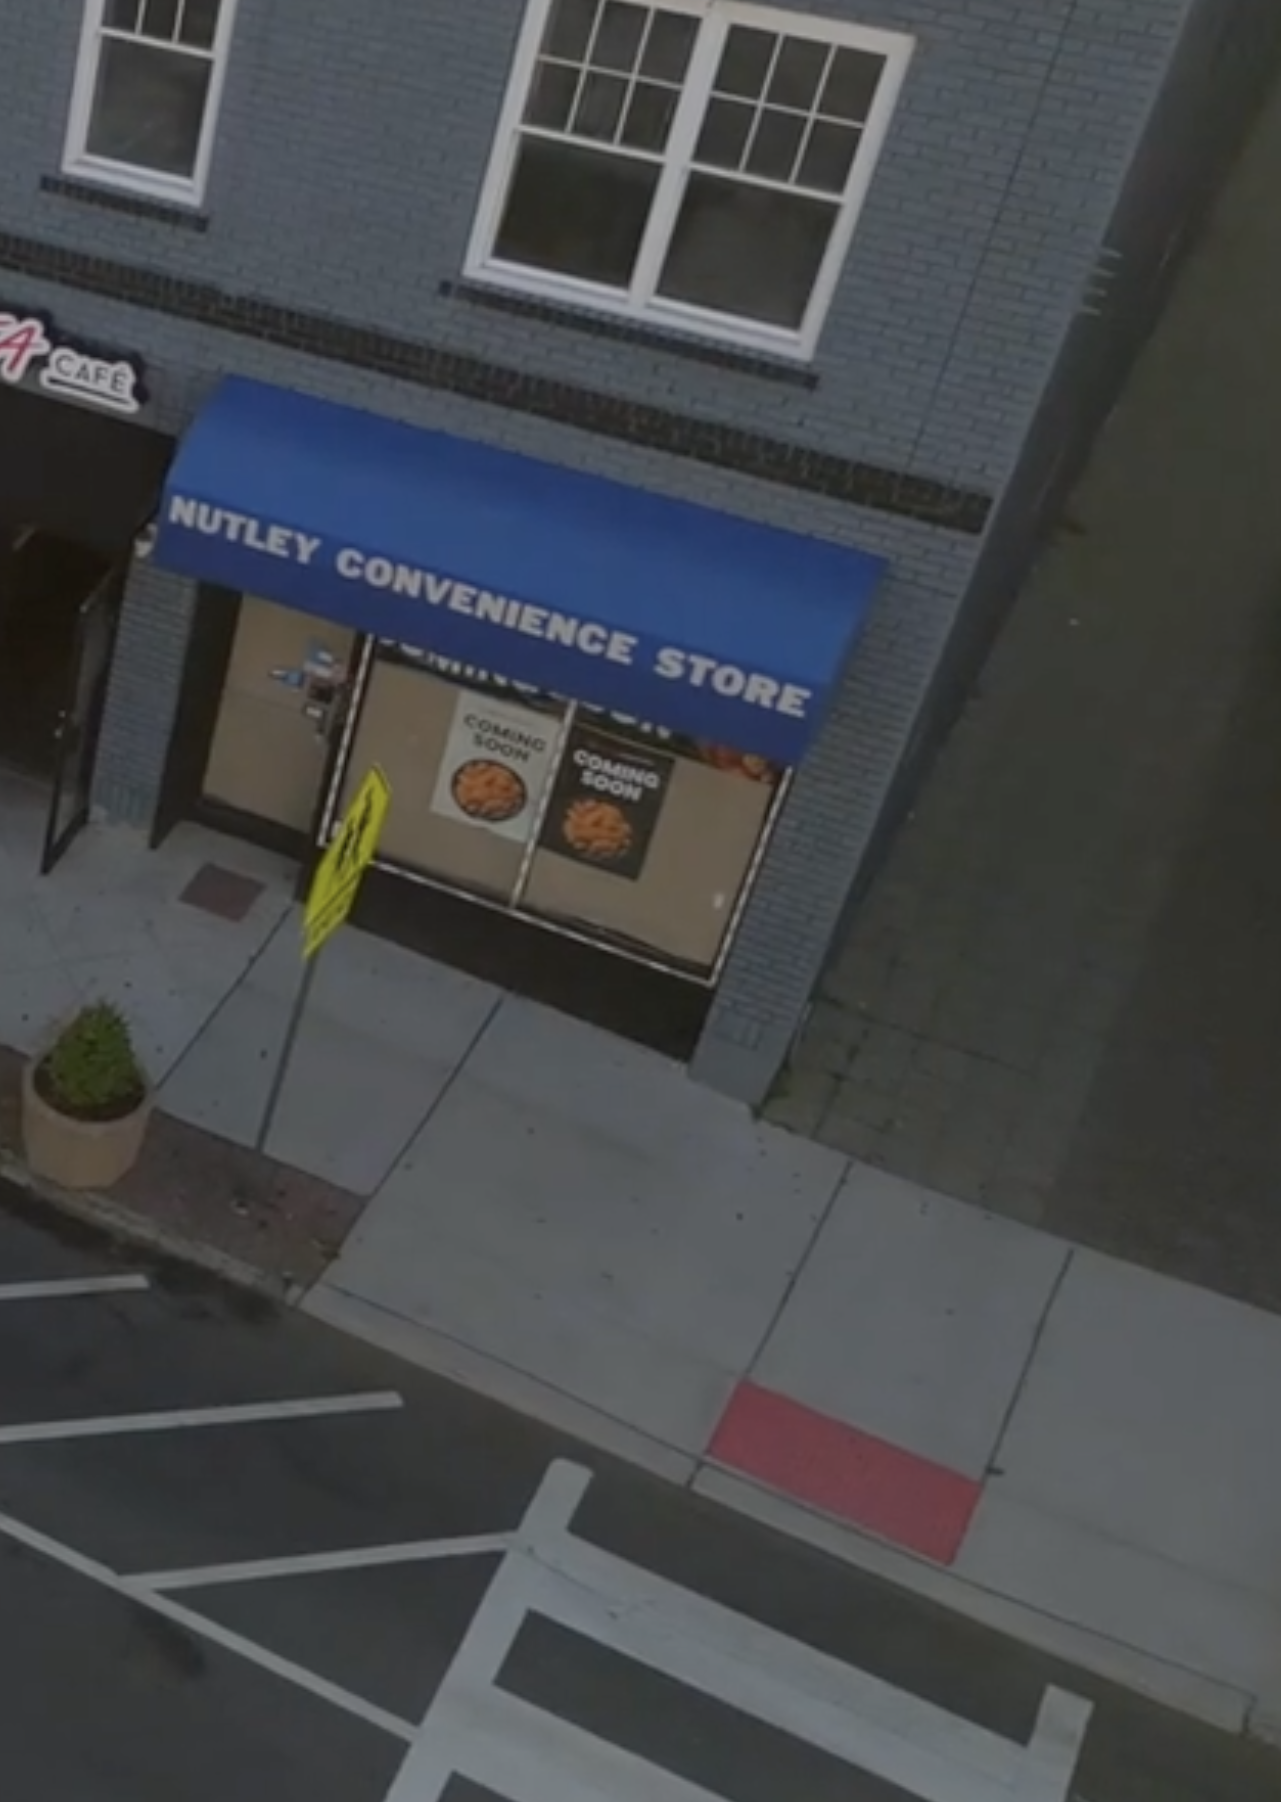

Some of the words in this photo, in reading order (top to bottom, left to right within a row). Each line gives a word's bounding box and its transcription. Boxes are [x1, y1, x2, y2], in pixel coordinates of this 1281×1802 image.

[53, 352, 131, 395] CAFÉ
[169, 495, 322, 565] NUTLEY
[336, 547, 638, 666] CONVENIENCE
[653, 646, 812, 719] STORE
[463, 713, 547, 752] COMING
[472, 732, 531, 763] SOON
[572, 750, 661, 789] COMING
[580, 769, 645, 802] SOON
